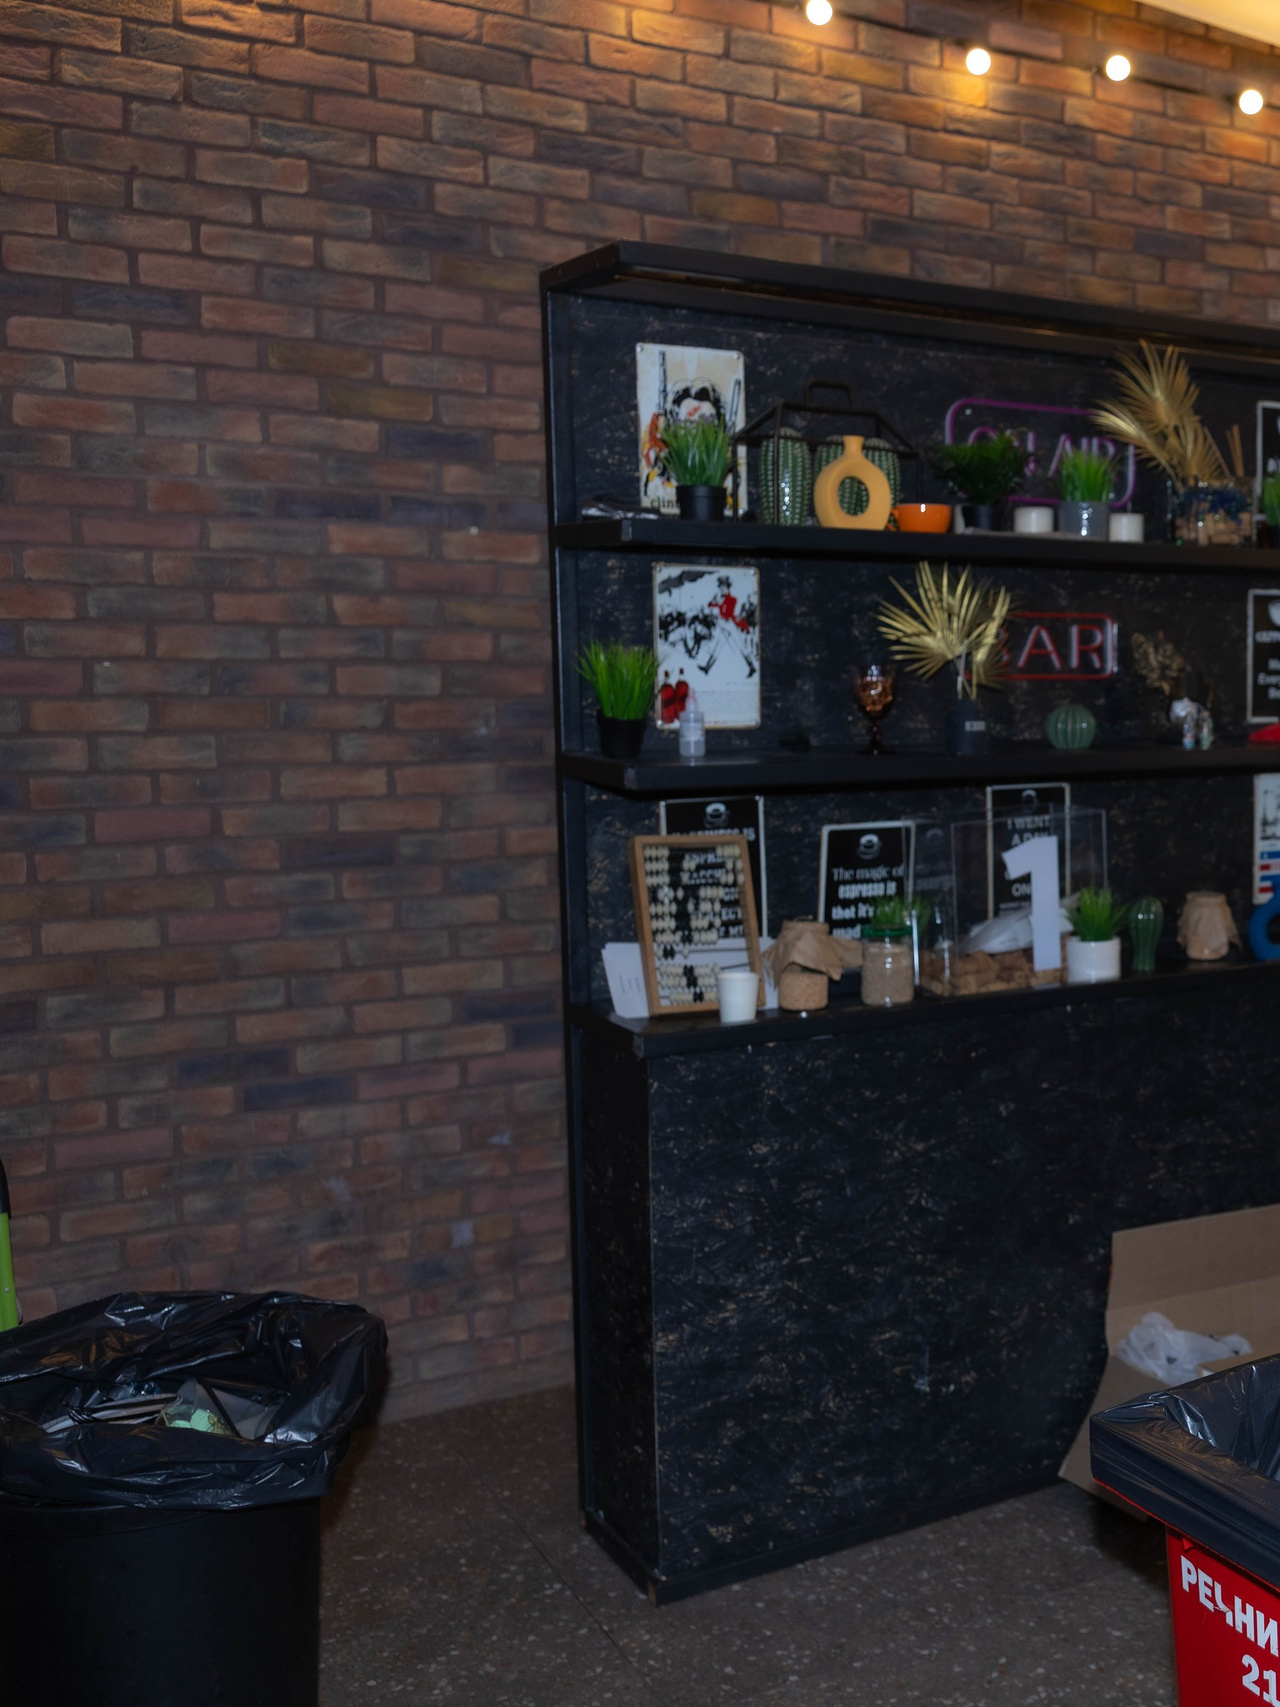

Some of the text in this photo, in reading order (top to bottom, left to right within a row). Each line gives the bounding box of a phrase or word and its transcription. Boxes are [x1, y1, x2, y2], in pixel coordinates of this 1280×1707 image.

[832, 866, 855, 881] The
[855, 865, 890, 881] magic
[838, 881, 886, 900] espresso
[831, 904, 857, 921] that
